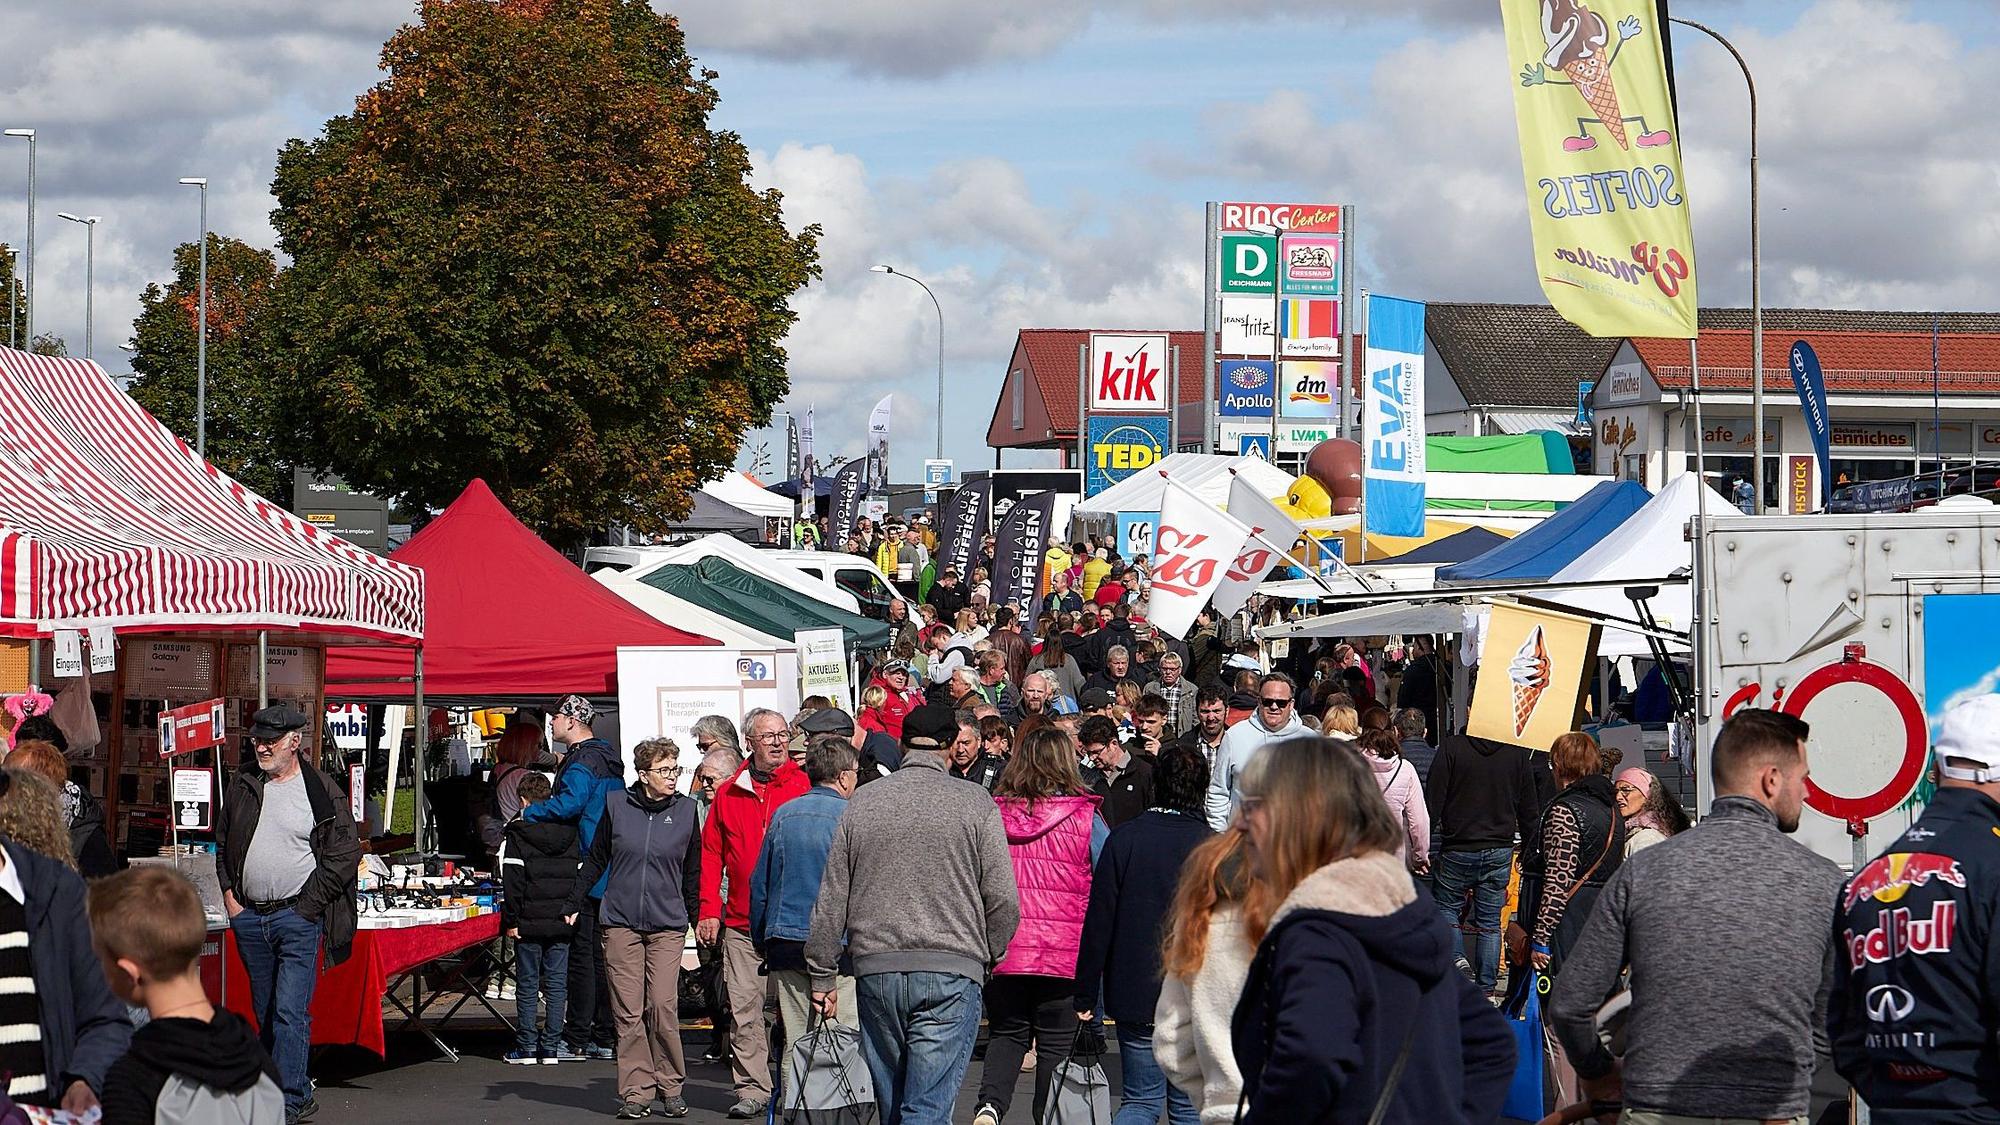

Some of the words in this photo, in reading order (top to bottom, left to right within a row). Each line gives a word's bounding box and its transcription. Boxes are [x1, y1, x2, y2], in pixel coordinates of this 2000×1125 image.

[1225, 205, 1290, 230] RING
[1290, 207, 1337, 229] Center
[1291, 270, 1331, 278] FRESSNAPF
[1228, 280, 1272, 288] DEICHMANN
[1241, 314, 1275, 338] fritz
[1311, 343, 1333, 352] family
[1296, 375, 1326, 393] dm
[1225, 393, 1273, 410] Apollo
[1801, 372, 1825, 435] HYUNDAI
[1371, 362, 1406, 472] EVA
[1983, 429, 2000, 444] Ca
[1093, 444, 1162, 469] TEDi
[308, 483, 336, 492] Tägliche
[1795, 461, 1806, 513] HSTÜCK
[1007, 508, 1026, 604] UTOHAUS
[1018, 509, 1042, 622] RAIFFEISEN
[152, 643, 192, 653] SAMSUNG
[266, 647, 298, 657] MSUNG
[55, 657, 82, 672] Eingang
[91, 655, 114, 670] Eingang
[152, 652, 180, 663] Galaxy
[808, 663, 840, 676] AKTUELLES
[664, 700, 717, 710] Tiergestützte
[666, 709, 700, 718] Therapie
[1893, 900, 1957, 957] Bull
